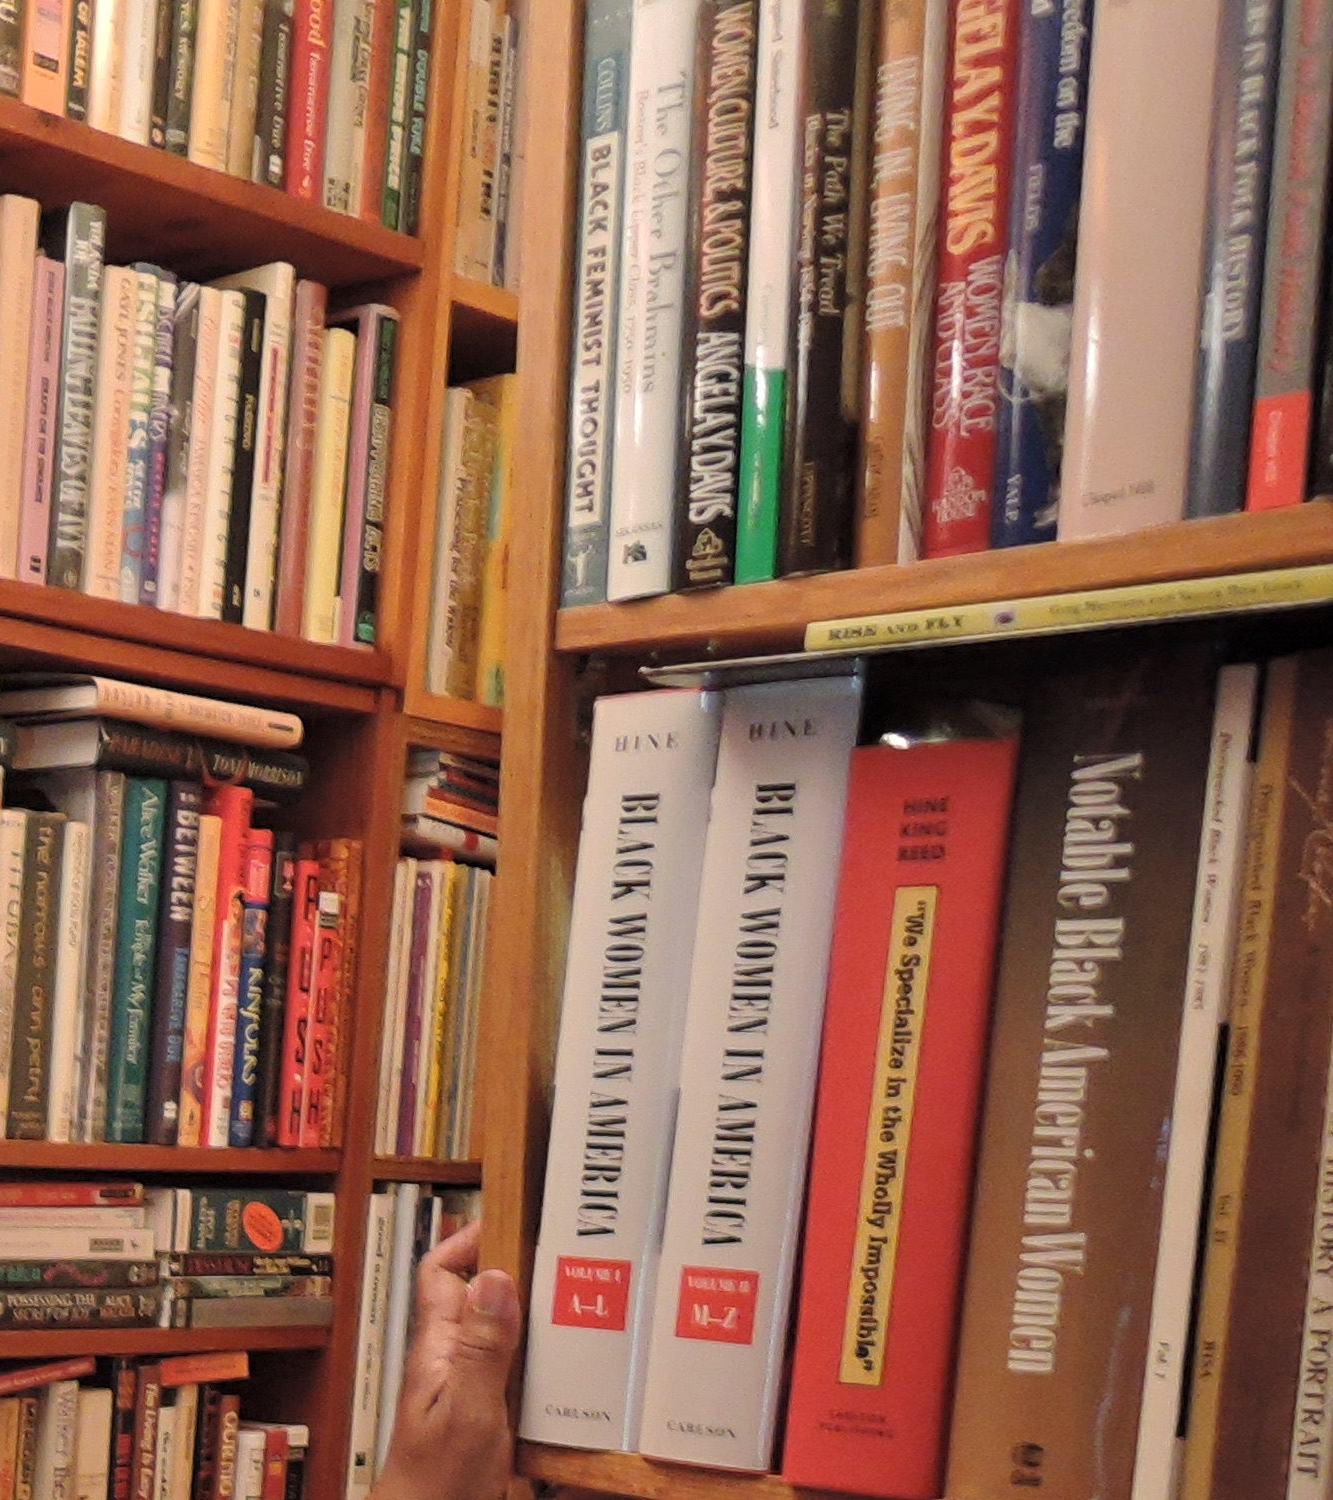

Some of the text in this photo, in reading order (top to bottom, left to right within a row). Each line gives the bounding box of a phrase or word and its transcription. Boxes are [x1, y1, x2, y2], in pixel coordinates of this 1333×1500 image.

[594, 57, 617, 132] COLLINS
[873, 54, 919, 142] LIVING
[639, 148, 683, 395] Other Brahmins
[818, 109, 850, 316] The Path We Tread
[866, 192, 910, 278] LIVING
[573, 143, 612, 517] BLACK FEMINIST THOUGHT
[863, 283, 905, 333] OUT
[56, 510, 87, 555] IVY
[614, 730, 680, 753] HINE
[747, 717, 819, 743] HINE
[168, 808, 195, 922] BETWEEN
[574, 792, 663, 1240] BLACK WOMEN IN AMERICA
[699, 781, 799, 1249] BLACK WOMEN IN AMERICA
[1005, 753, 1143, 1375] Notable Black American Women
[854, 900, 931, 1373] "We Specialize in the Wholly Impossible"
[1293, 1327, 1333, 1480] PORTRAIT
